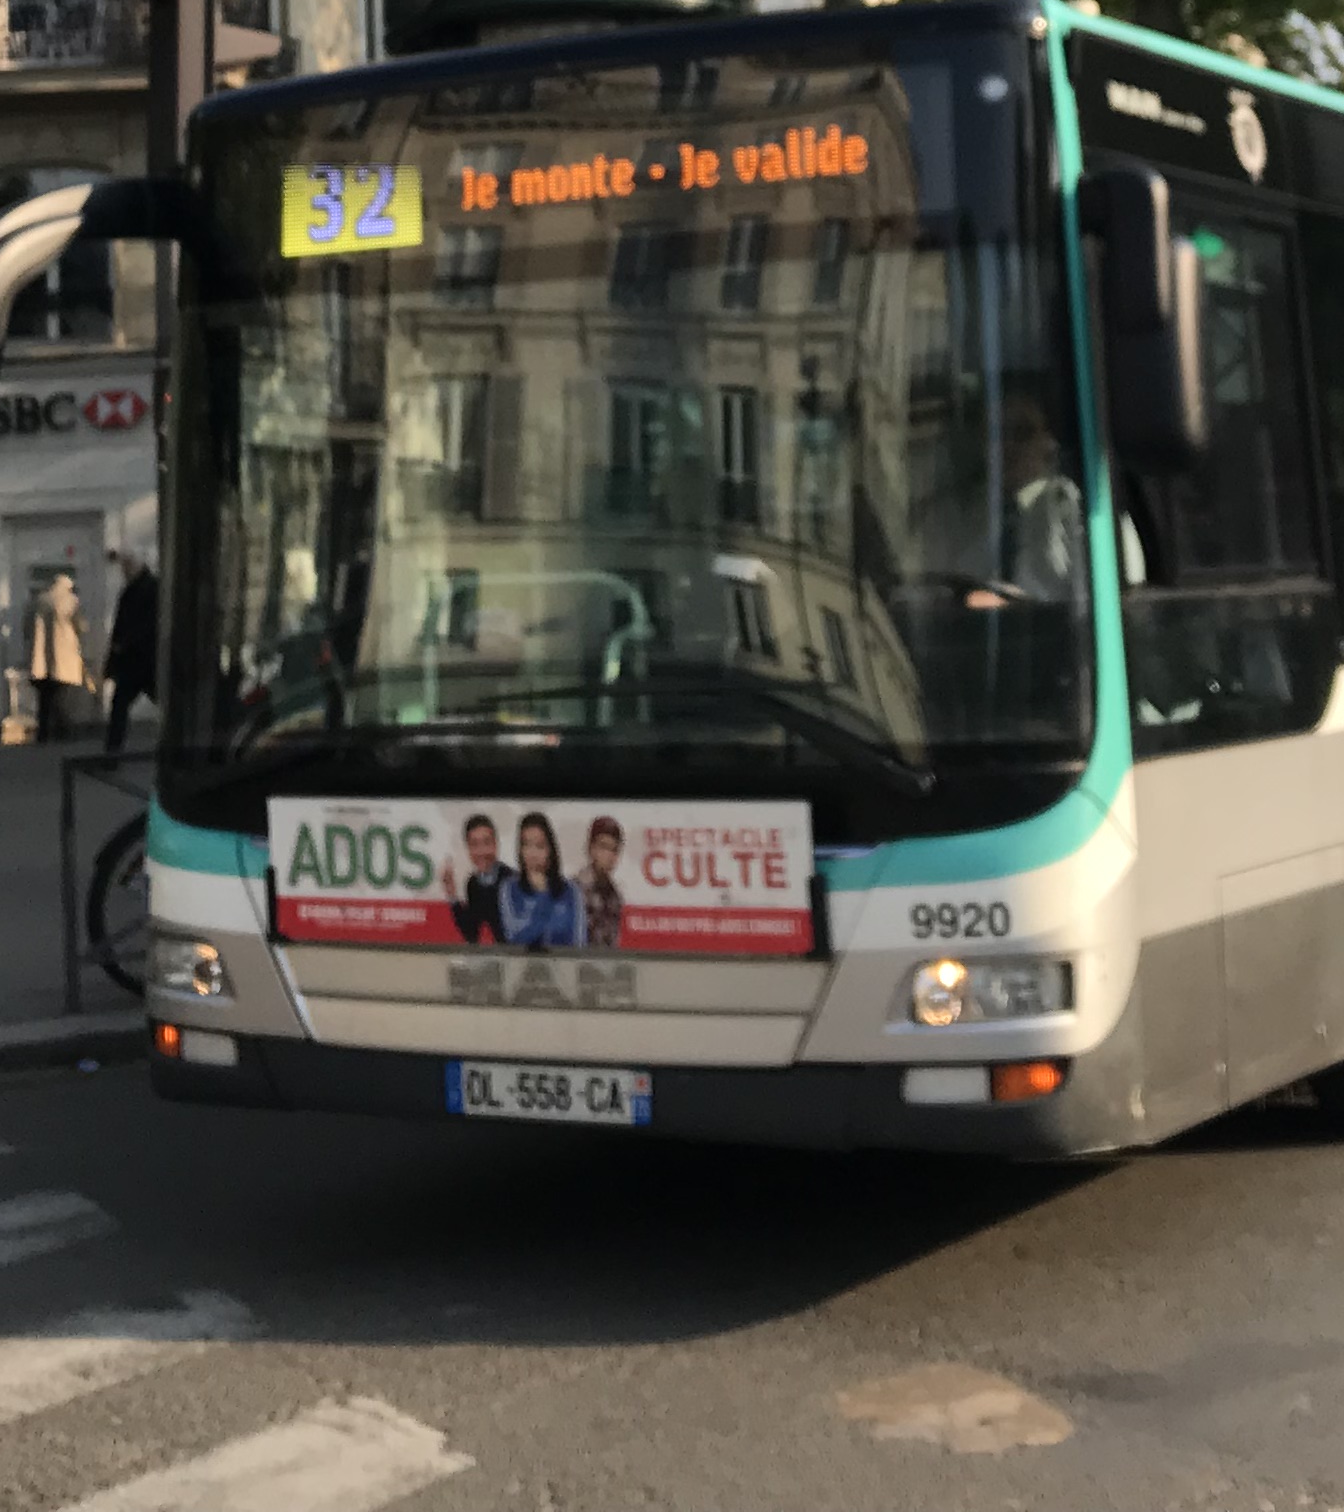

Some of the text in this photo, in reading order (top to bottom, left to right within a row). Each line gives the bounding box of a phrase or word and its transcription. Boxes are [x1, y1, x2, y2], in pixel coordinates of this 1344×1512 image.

[511, 154, 636, 206] monte
[732, 123, 868, 184] valide
[308, 165, 395, 244] 32
[288, 822, 434, 888] ADOS
[643, 828, 784, 848] SPECTACLE
[641, 851, 790, 890] CULTE
[911, 901, 1011, 939] 9920
